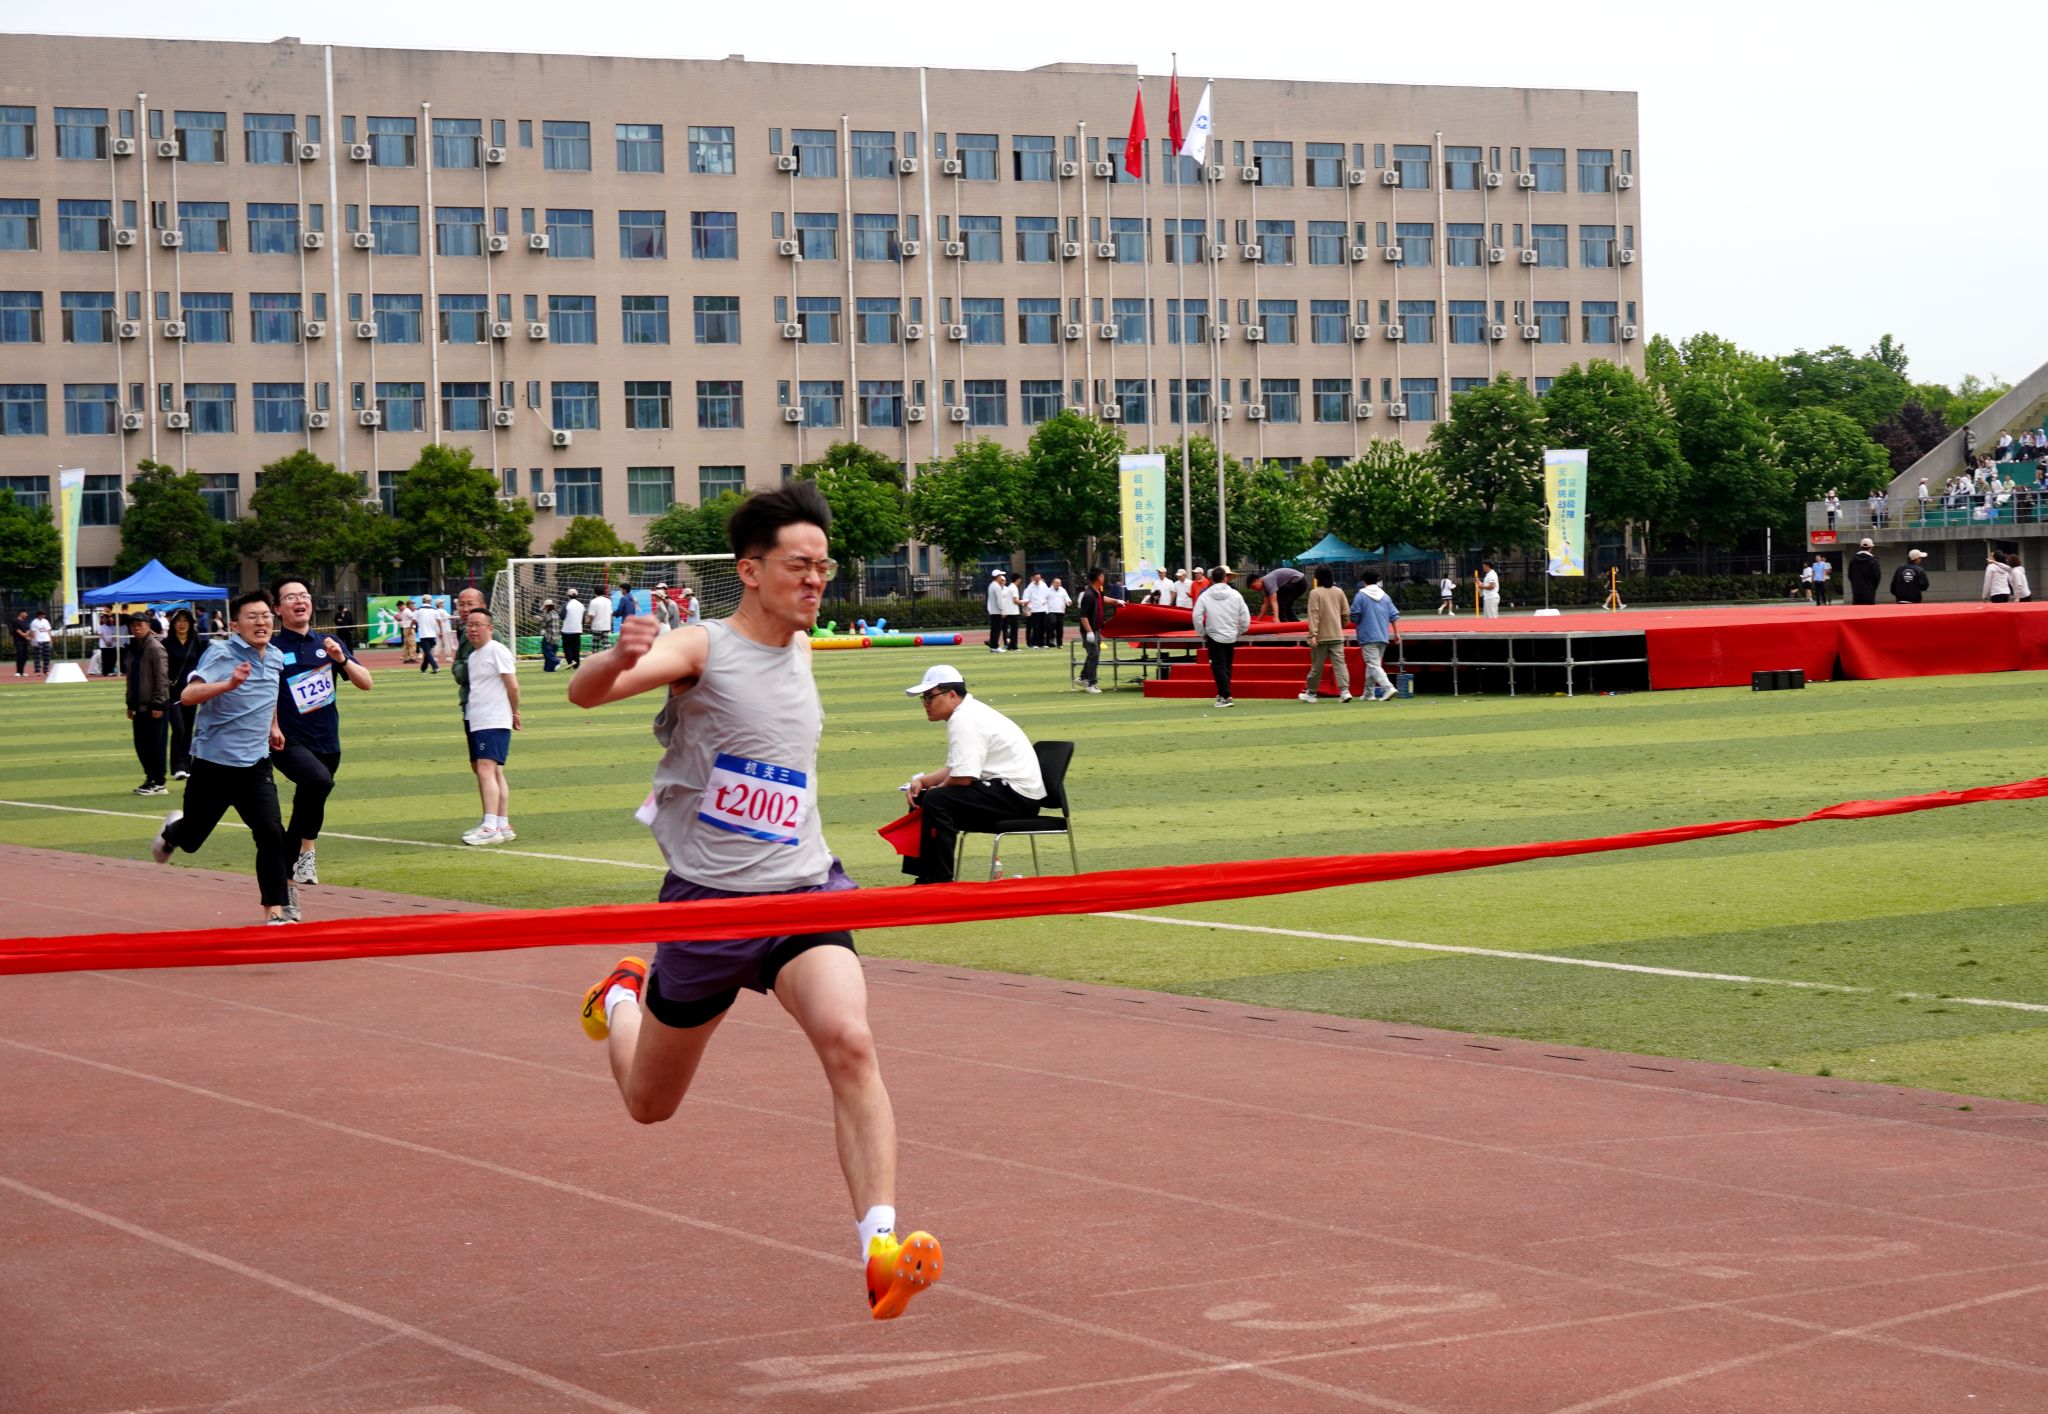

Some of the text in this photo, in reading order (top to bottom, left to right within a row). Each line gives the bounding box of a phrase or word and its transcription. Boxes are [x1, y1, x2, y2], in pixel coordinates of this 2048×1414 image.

[297, 677, 331, 699] T236
[744, 760, 790, 782] 机关三
[715, 783, 799, 828] t2002
